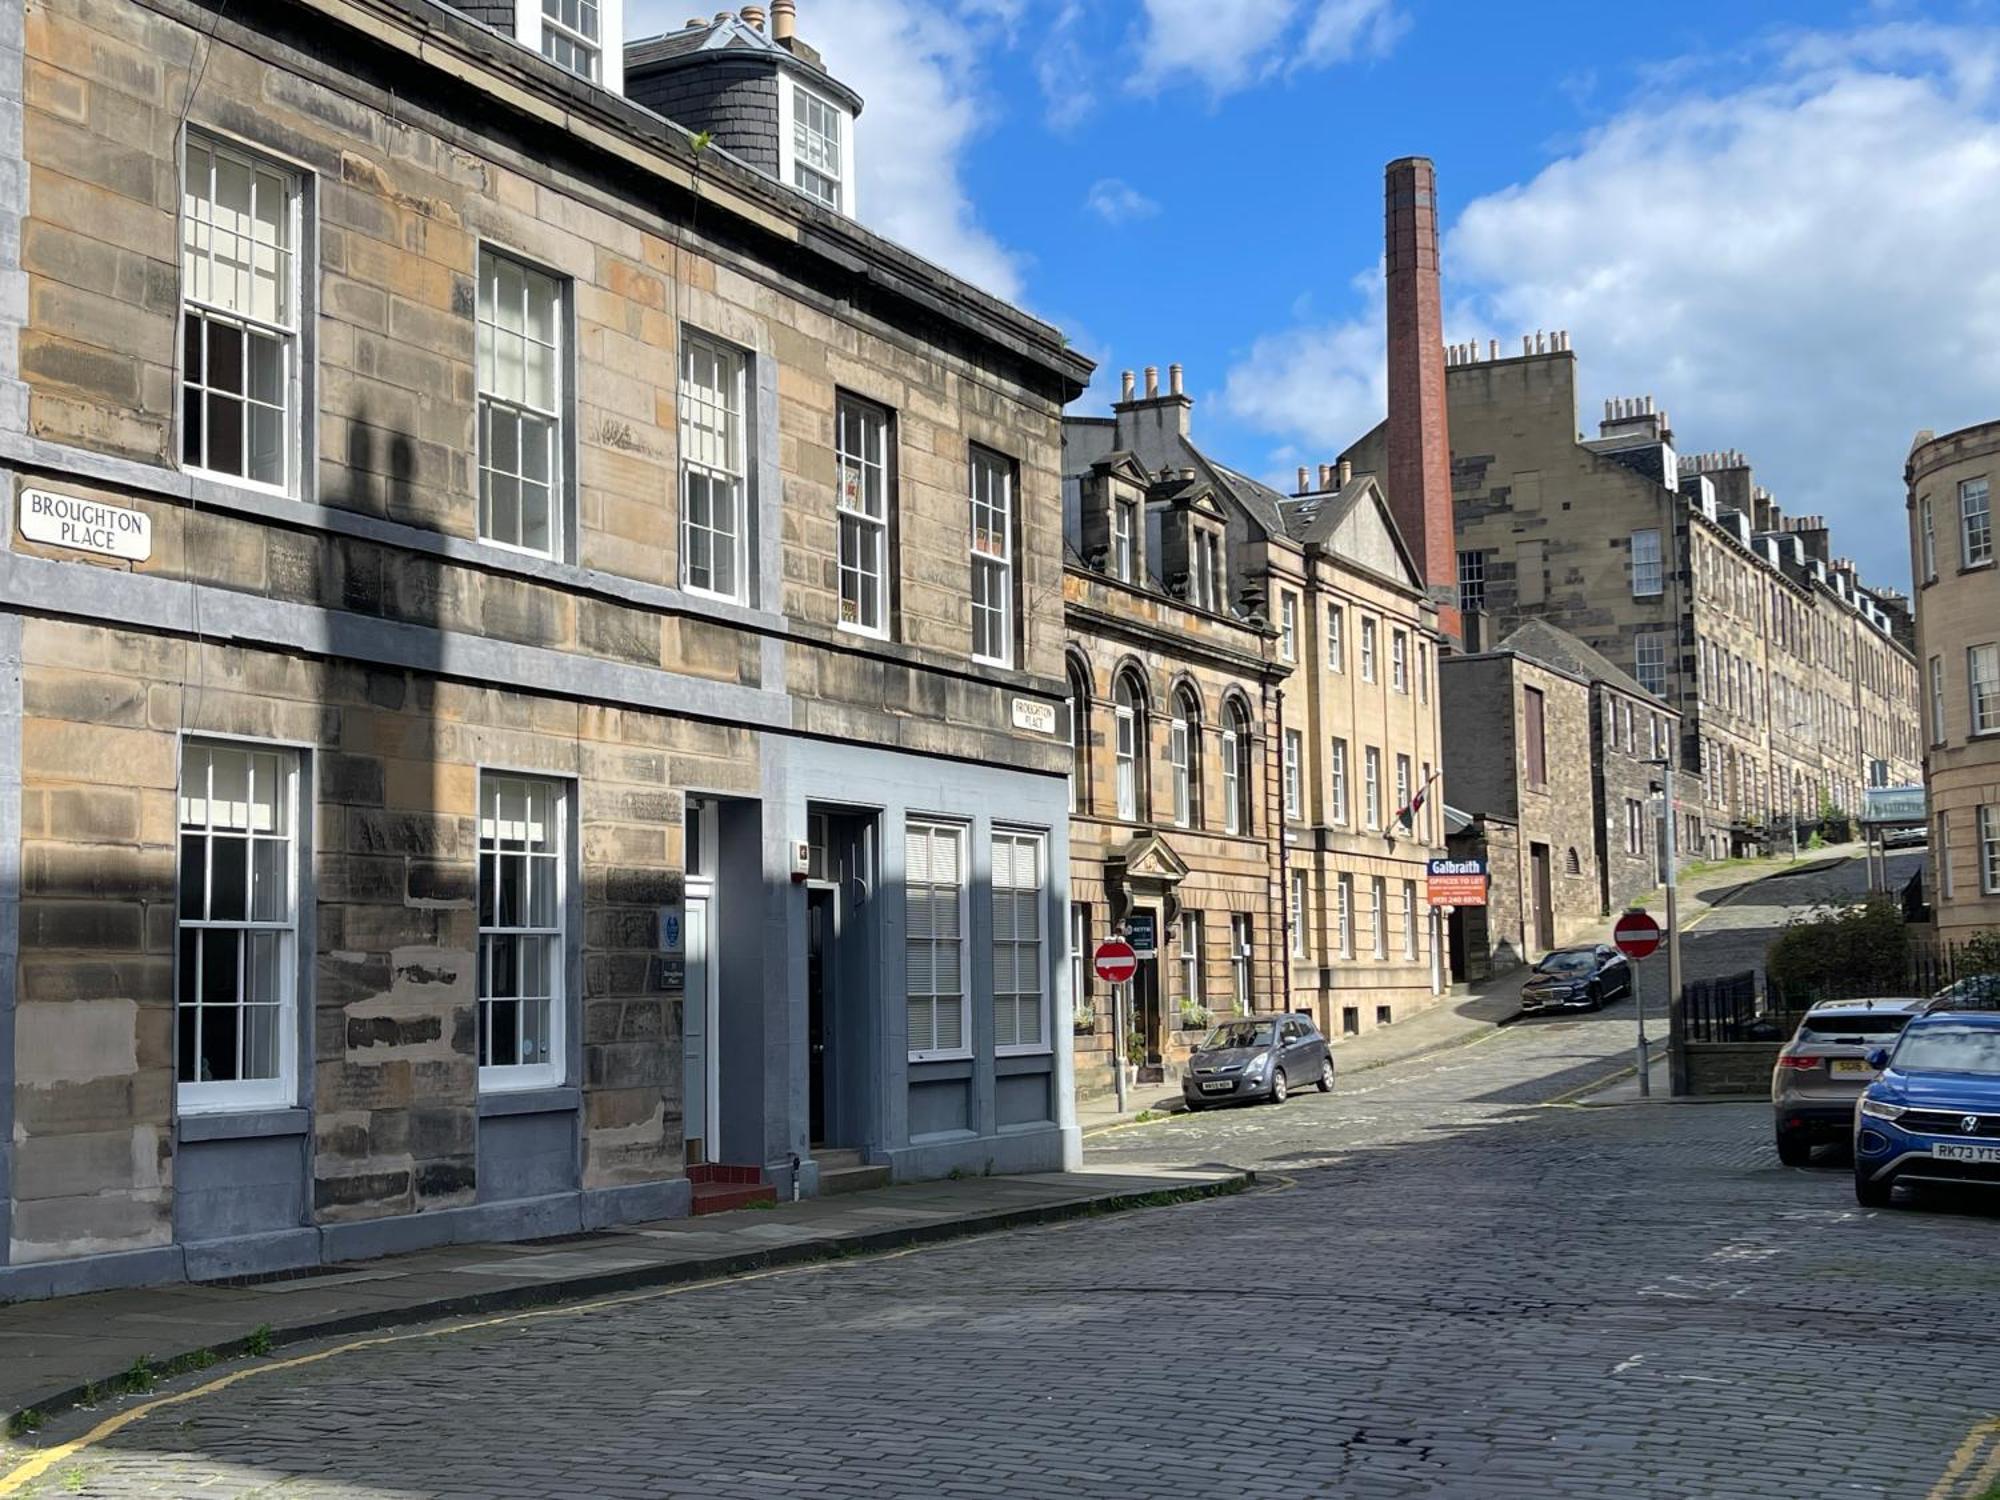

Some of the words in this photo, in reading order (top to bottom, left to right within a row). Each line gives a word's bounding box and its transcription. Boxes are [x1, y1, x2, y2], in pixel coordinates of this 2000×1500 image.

[31, 493, 143, 535] BROUGHTON
[61, 521, 116, 550] PLACE
[1432, 860, 1480, 874] Galbraith
[1429, 877, 1459, 885] OFFICES
[1460, 877, 1470, 885] TO
[1471, 877, 1484, 885] LET
[1938, 1145, 1974, 1159] RK73
[1975, 1147, 2000, 1161] YTS
